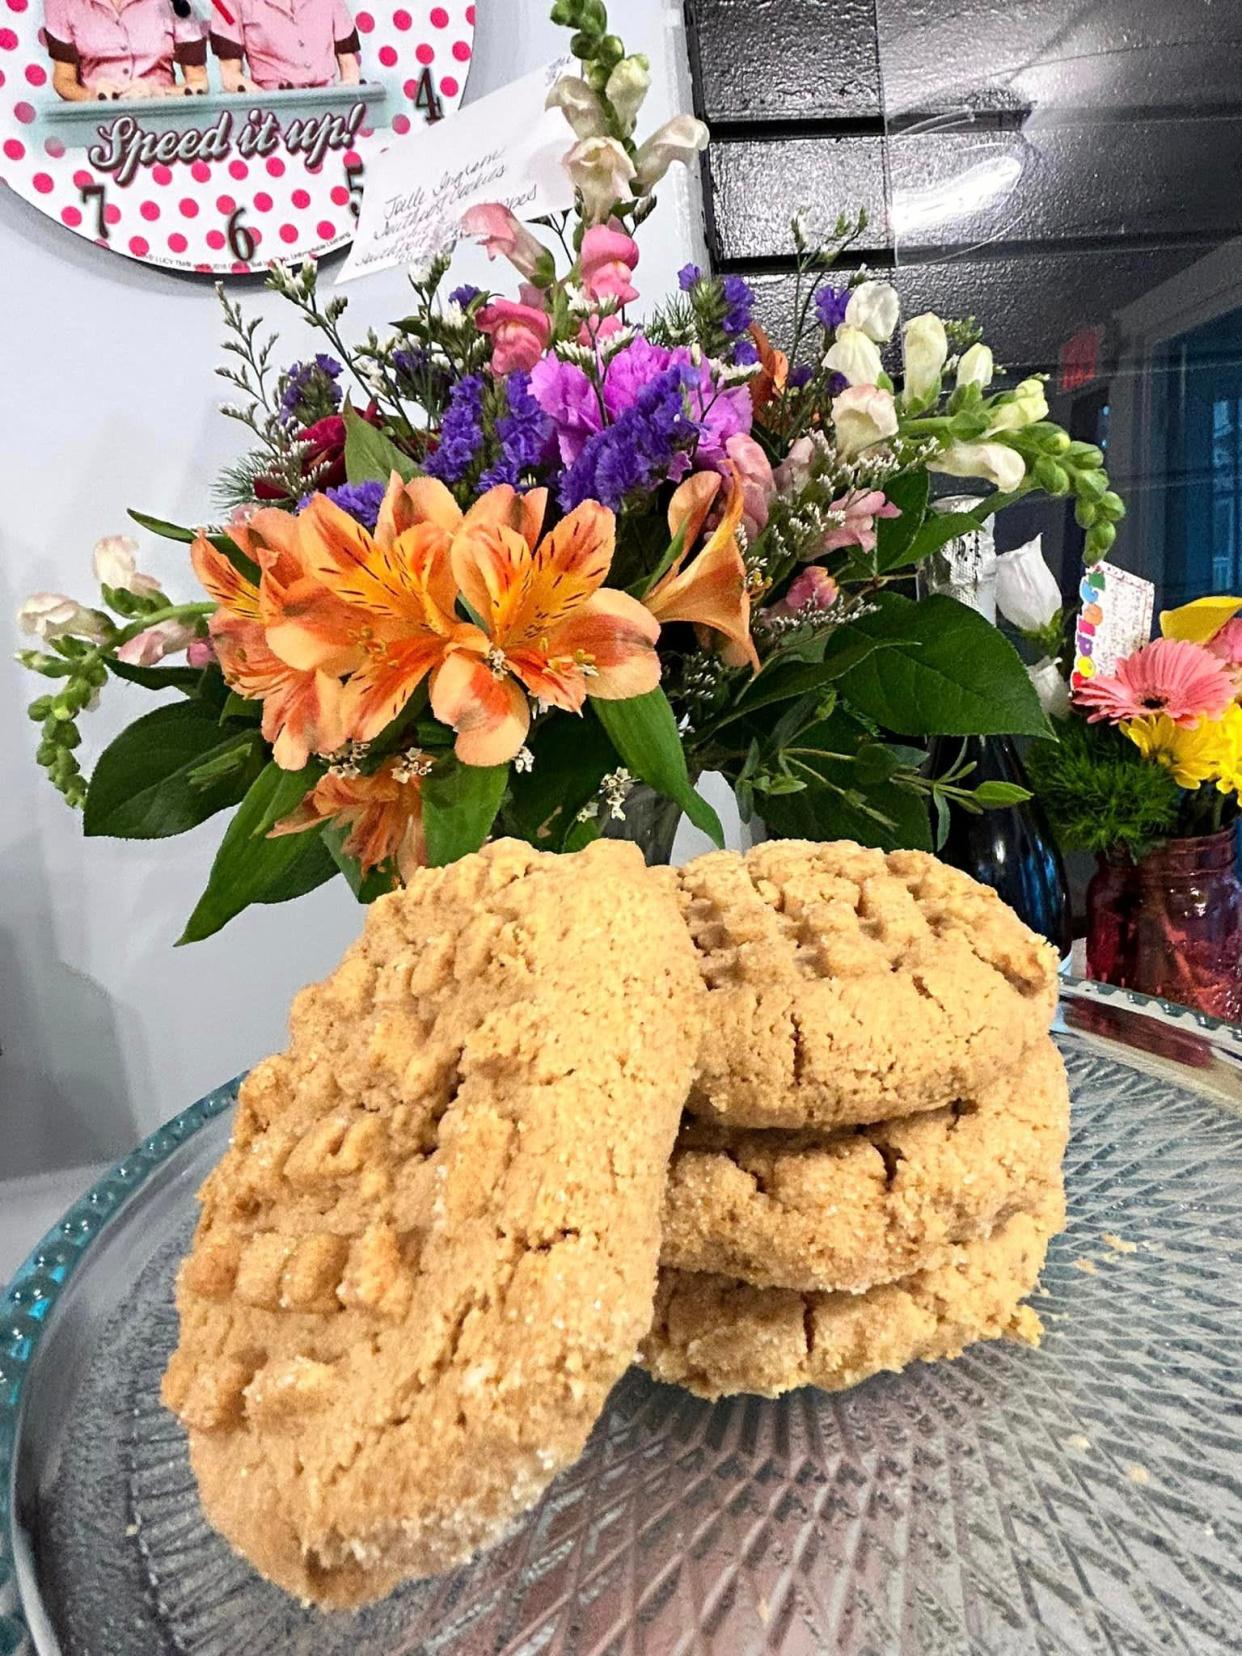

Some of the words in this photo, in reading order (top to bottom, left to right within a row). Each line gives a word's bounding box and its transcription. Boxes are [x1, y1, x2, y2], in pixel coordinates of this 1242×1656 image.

[415, 68, 444, 124] 4
[88, 110, 231, 187] Speed
[237, 108, 280, 159] it
[284, 103, 367, 169] up!
[80, 184, 109, 239] 7
[346, 163, 364, 218] 5
[227, 207, 256, 262] 6
